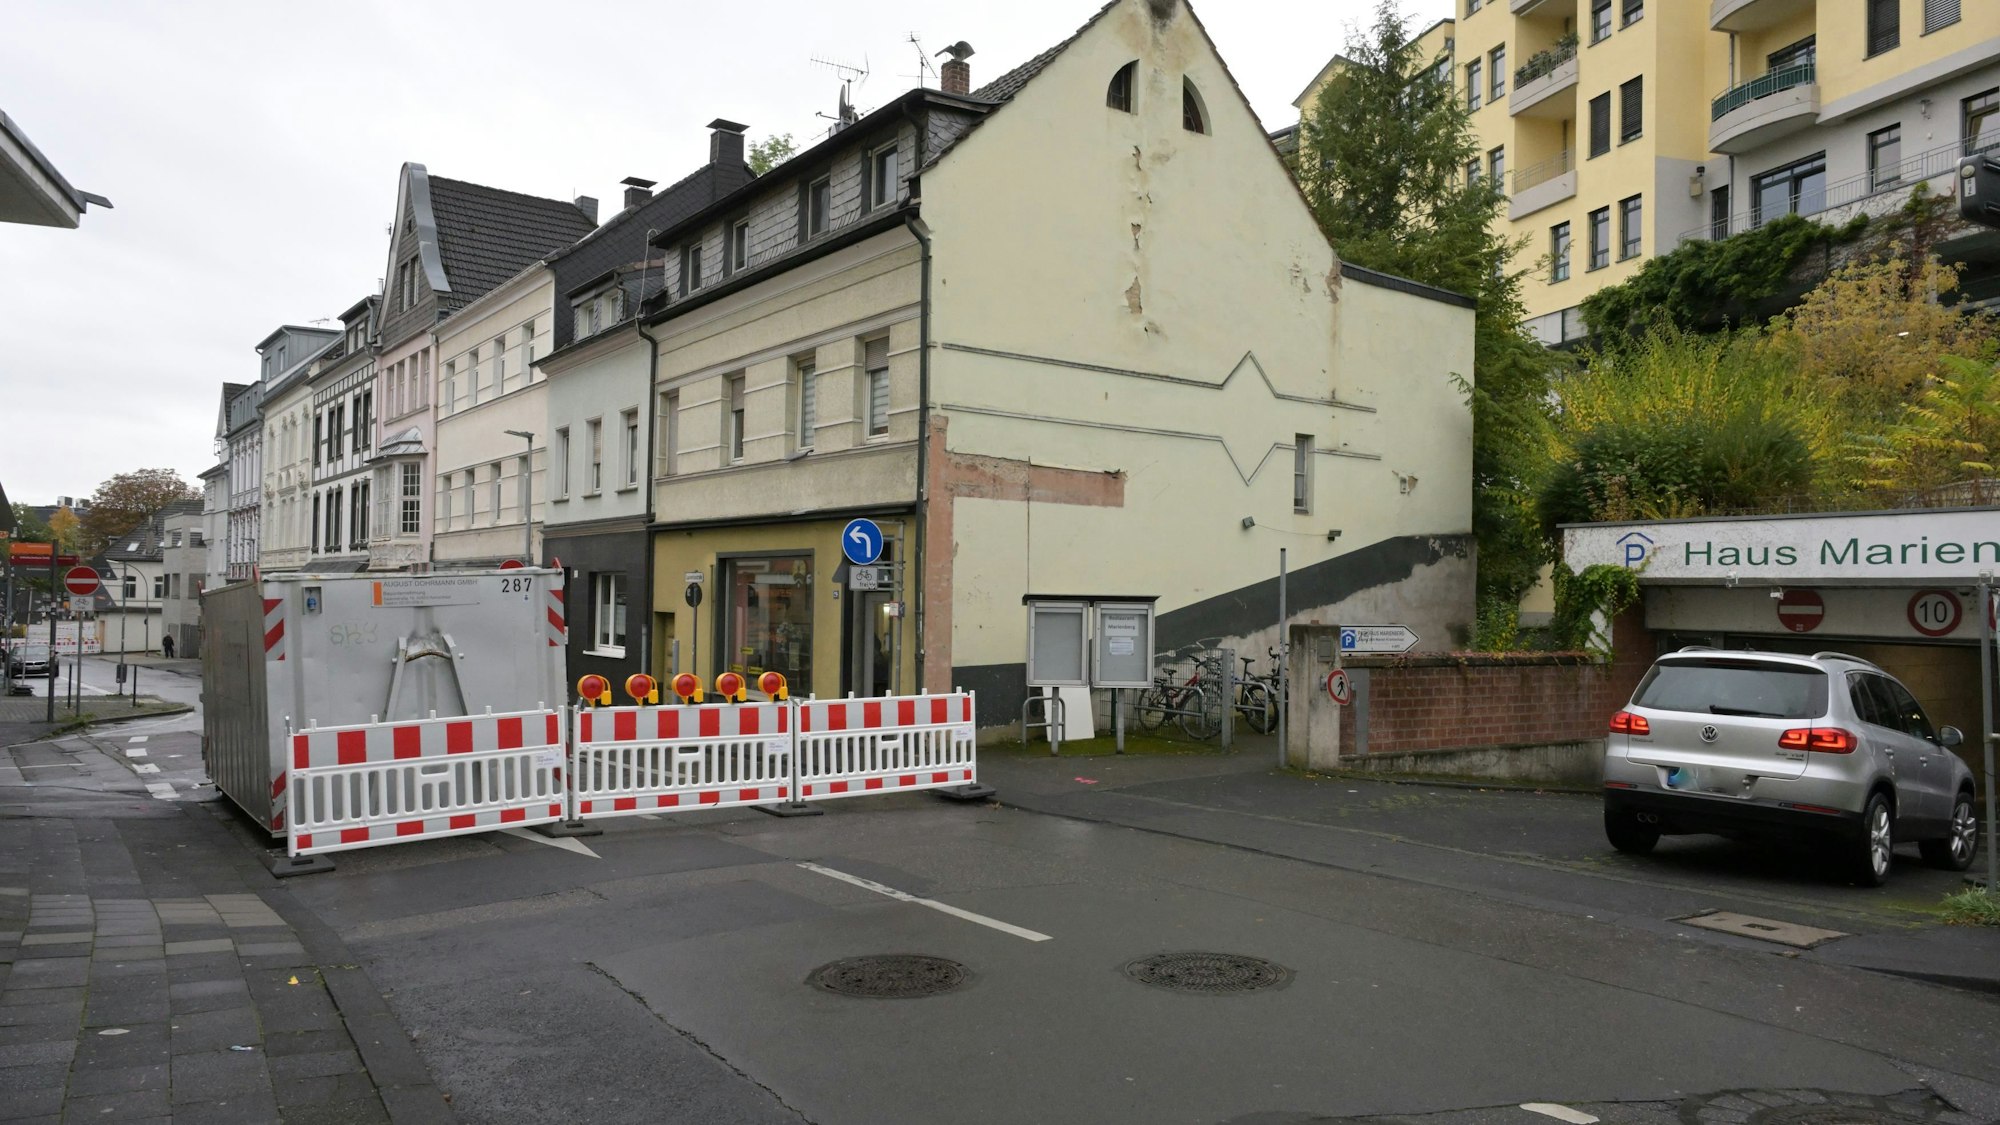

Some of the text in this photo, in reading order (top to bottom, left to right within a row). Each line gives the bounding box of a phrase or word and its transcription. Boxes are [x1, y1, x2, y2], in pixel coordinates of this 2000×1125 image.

[1685, 536, 2000, 566] Haus Marien
[383, 580, 413, 588] AUGUST
[415, 579, 455, 587] DOHRMANN
[501, 578, 532, 593] 287
[1917, 600, 1947, 623] 10
[1108, 622, 1136, 631] Marienberg
